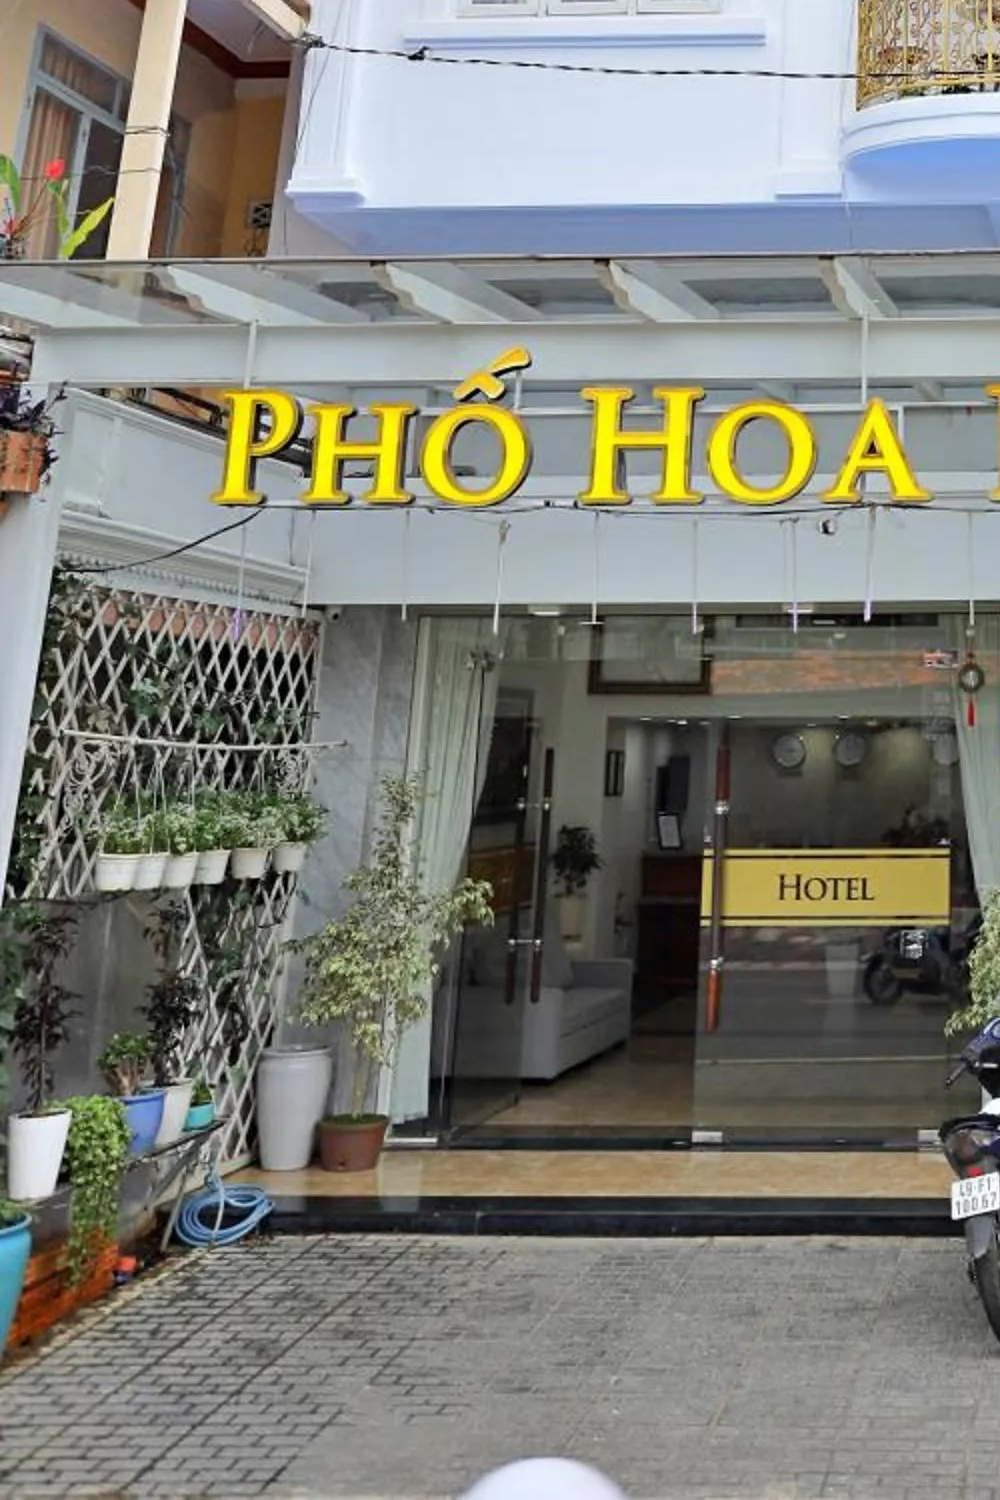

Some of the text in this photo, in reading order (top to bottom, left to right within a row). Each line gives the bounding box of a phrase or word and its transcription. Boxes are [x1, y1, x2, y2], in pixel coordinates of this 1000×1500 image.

[211, 344, 533, 506] PHỐ
[580, 386, 936, 506] HOA
[777, 873, 876, 902] HOTEL
